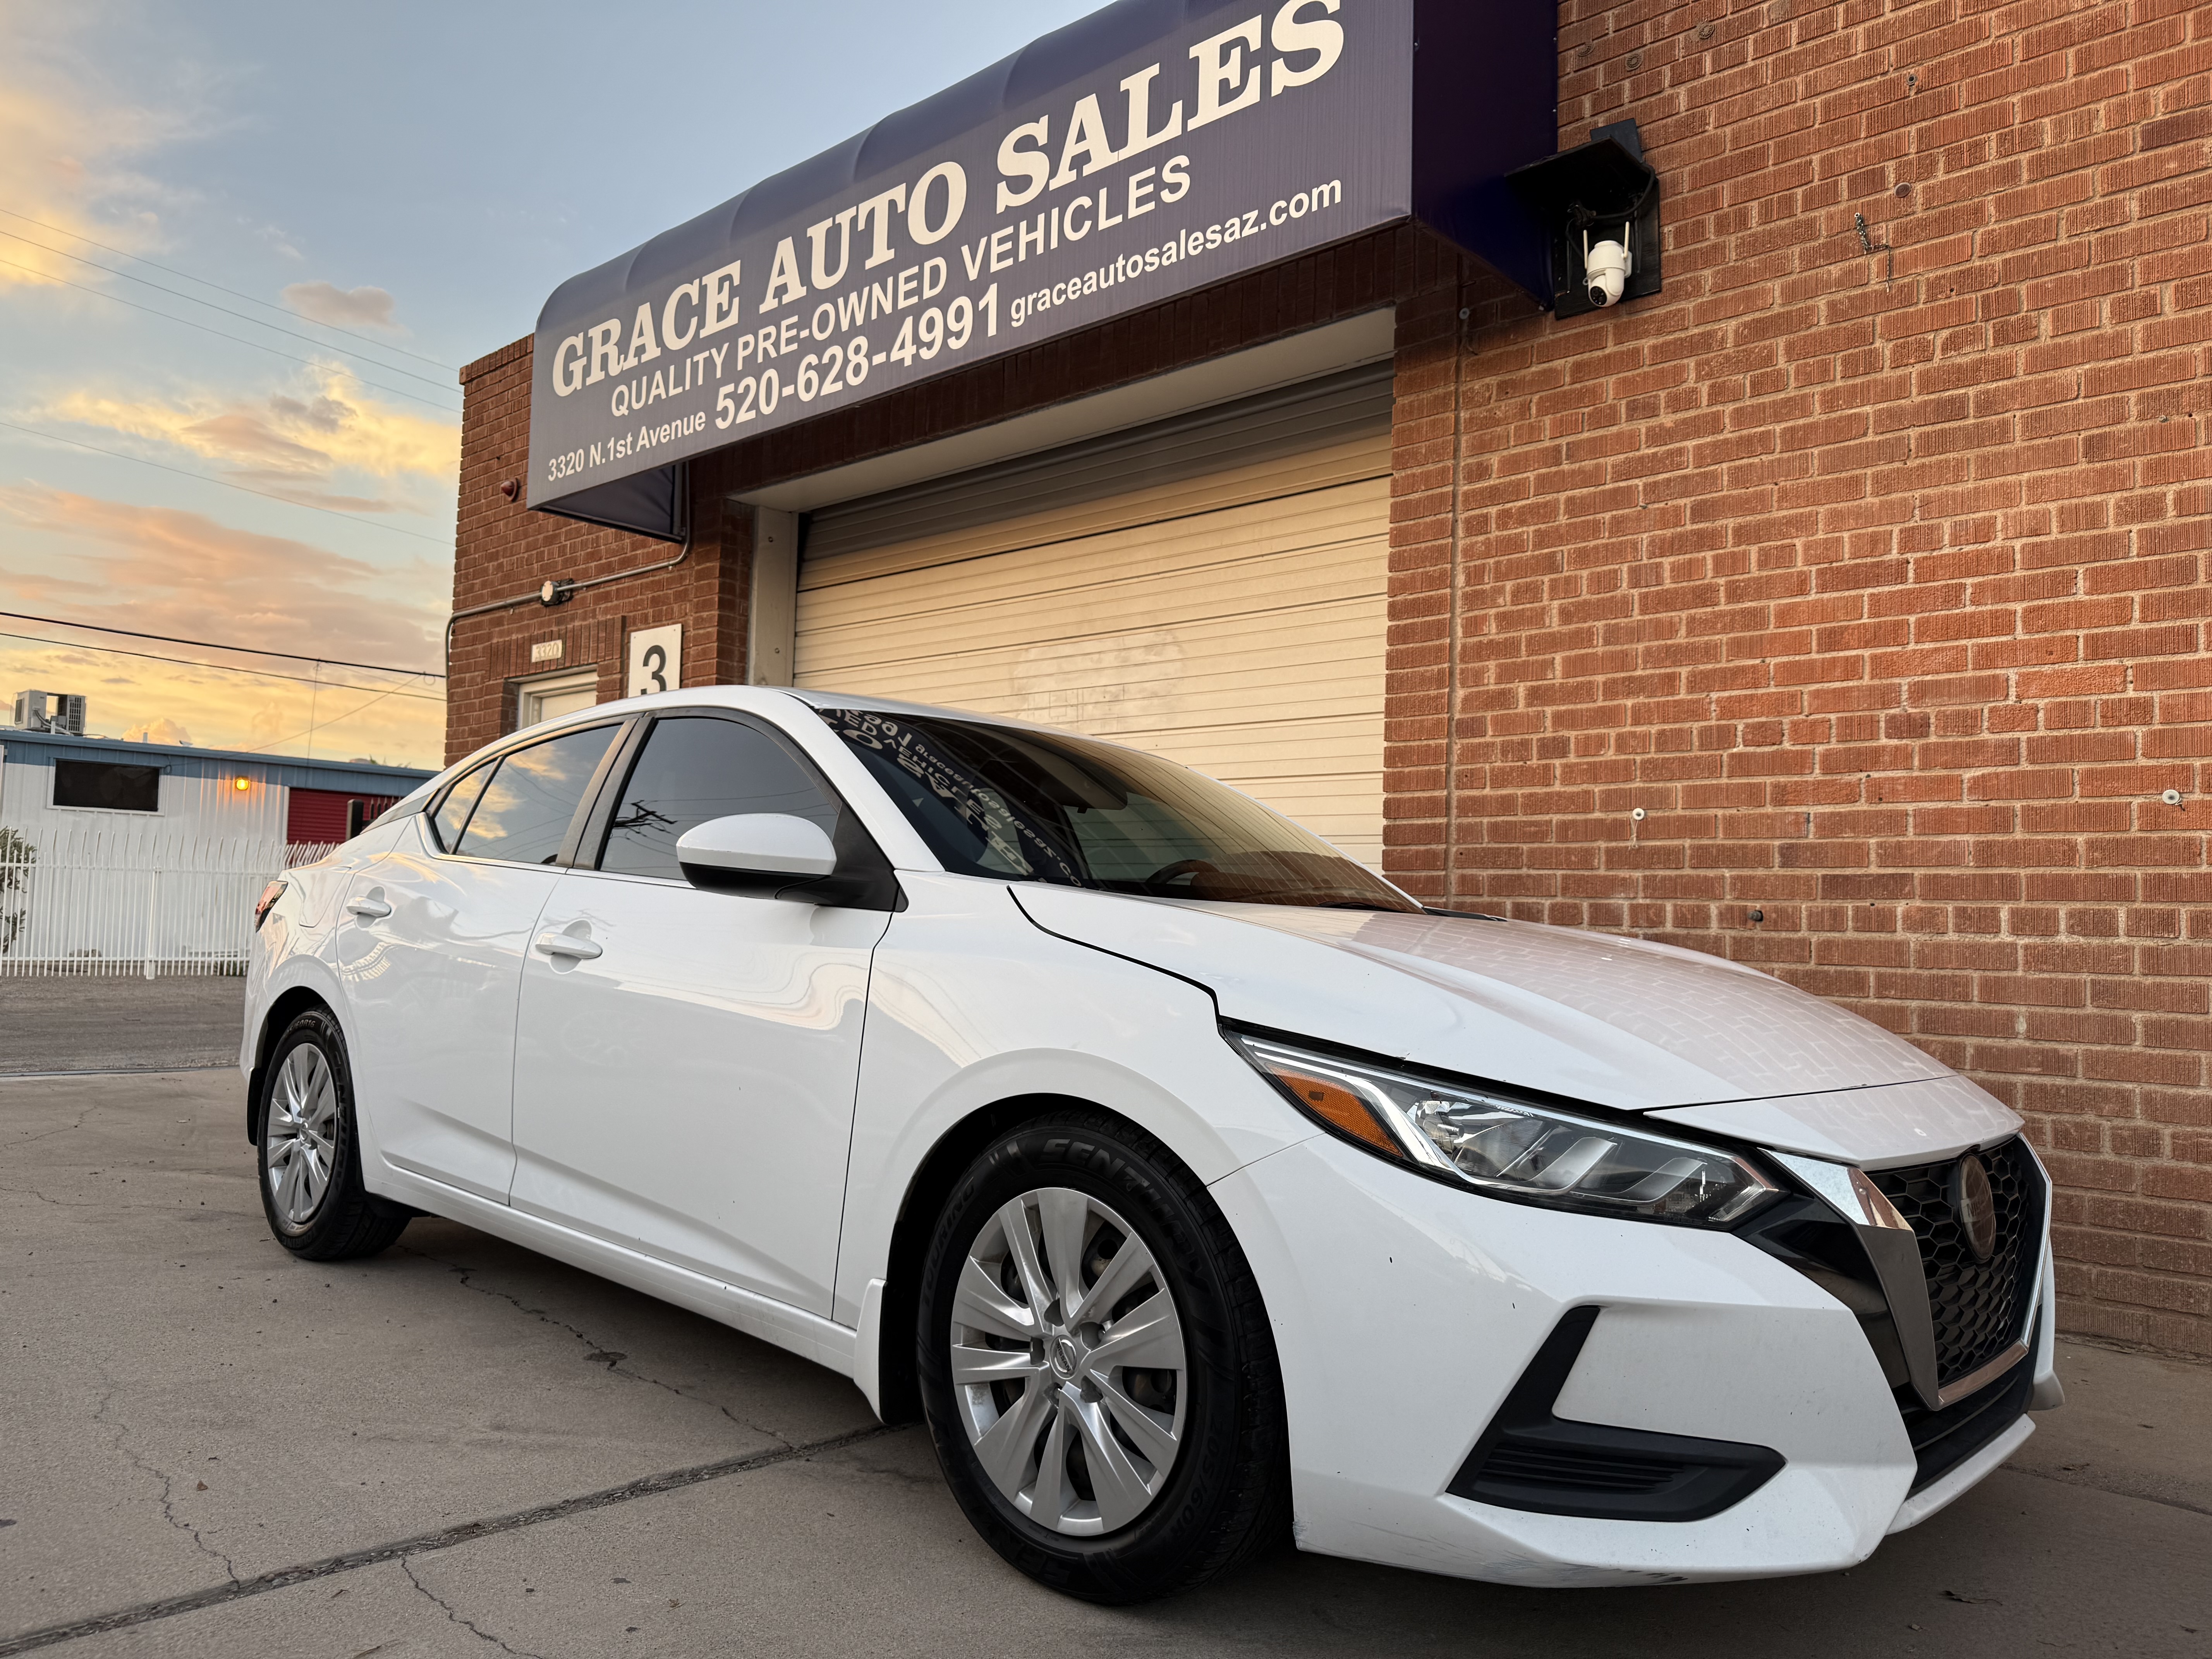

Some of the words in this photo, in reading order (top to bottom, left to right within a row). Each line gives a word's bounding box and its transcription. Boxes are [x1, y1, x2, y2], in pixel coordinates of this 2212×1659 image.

[553, 260, 740, 397] GRACE
[759, 162, 966, 314] AUTO
[996, 0, 1343, 214] SALES
[611, 343, 729, 416] QUALITY
[737, 257, 946, 371] PRE-OWNED
[961, 155, 1190, 281] VEHICLES
[548, 449, 584, 481] 3320
[590, 432, 632, 467] N.1st
[636, 412, 706, 452] Avenue
[715, 283, 997, 429] 520-628-4991
[1011, 180, 1341, 327] graceautosalesaz.com
[536, 642, 559, 660] 3320
[641, 645, 667, 695] 3
